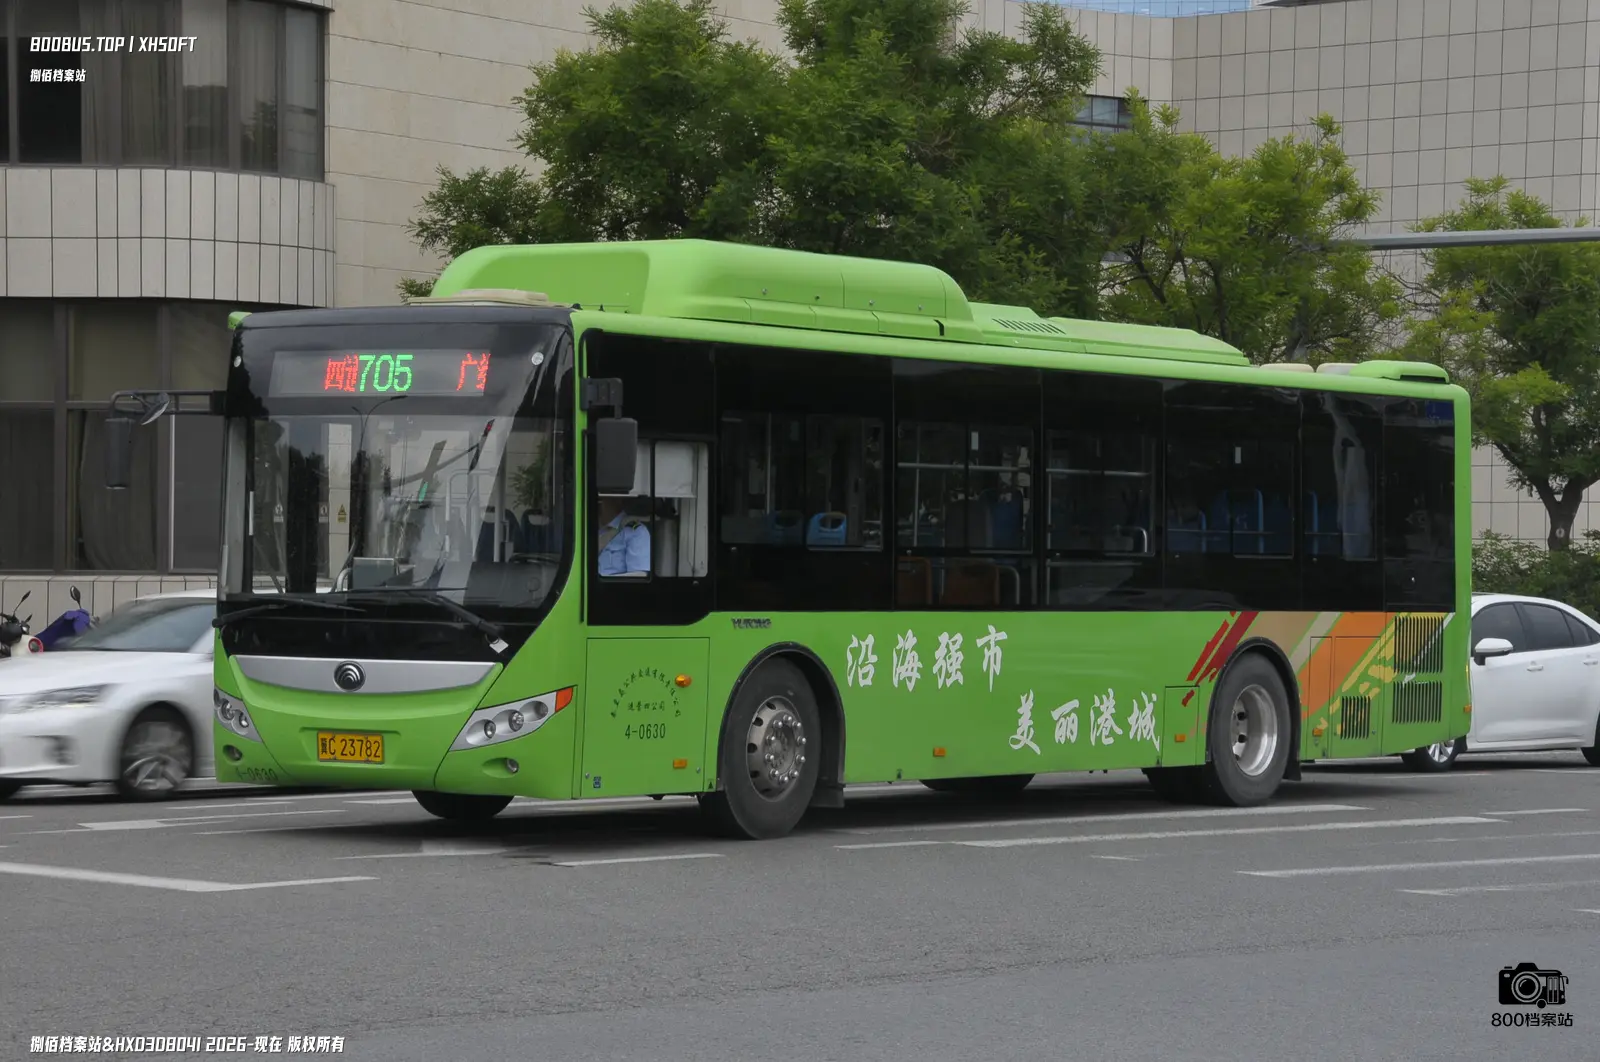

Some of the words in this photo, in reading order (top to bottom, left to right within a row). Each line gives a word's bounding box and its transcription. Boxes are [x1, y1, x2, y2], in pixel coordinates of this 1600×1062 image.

[359, 354, 414, 392] 705
[846, 624, 1008, 692] 沿海强市
[624, 722, 666, 740] 4-0630
[1008, 688, 1161, 755] 美丽港城
[340, 738, 381, 758] 23782
